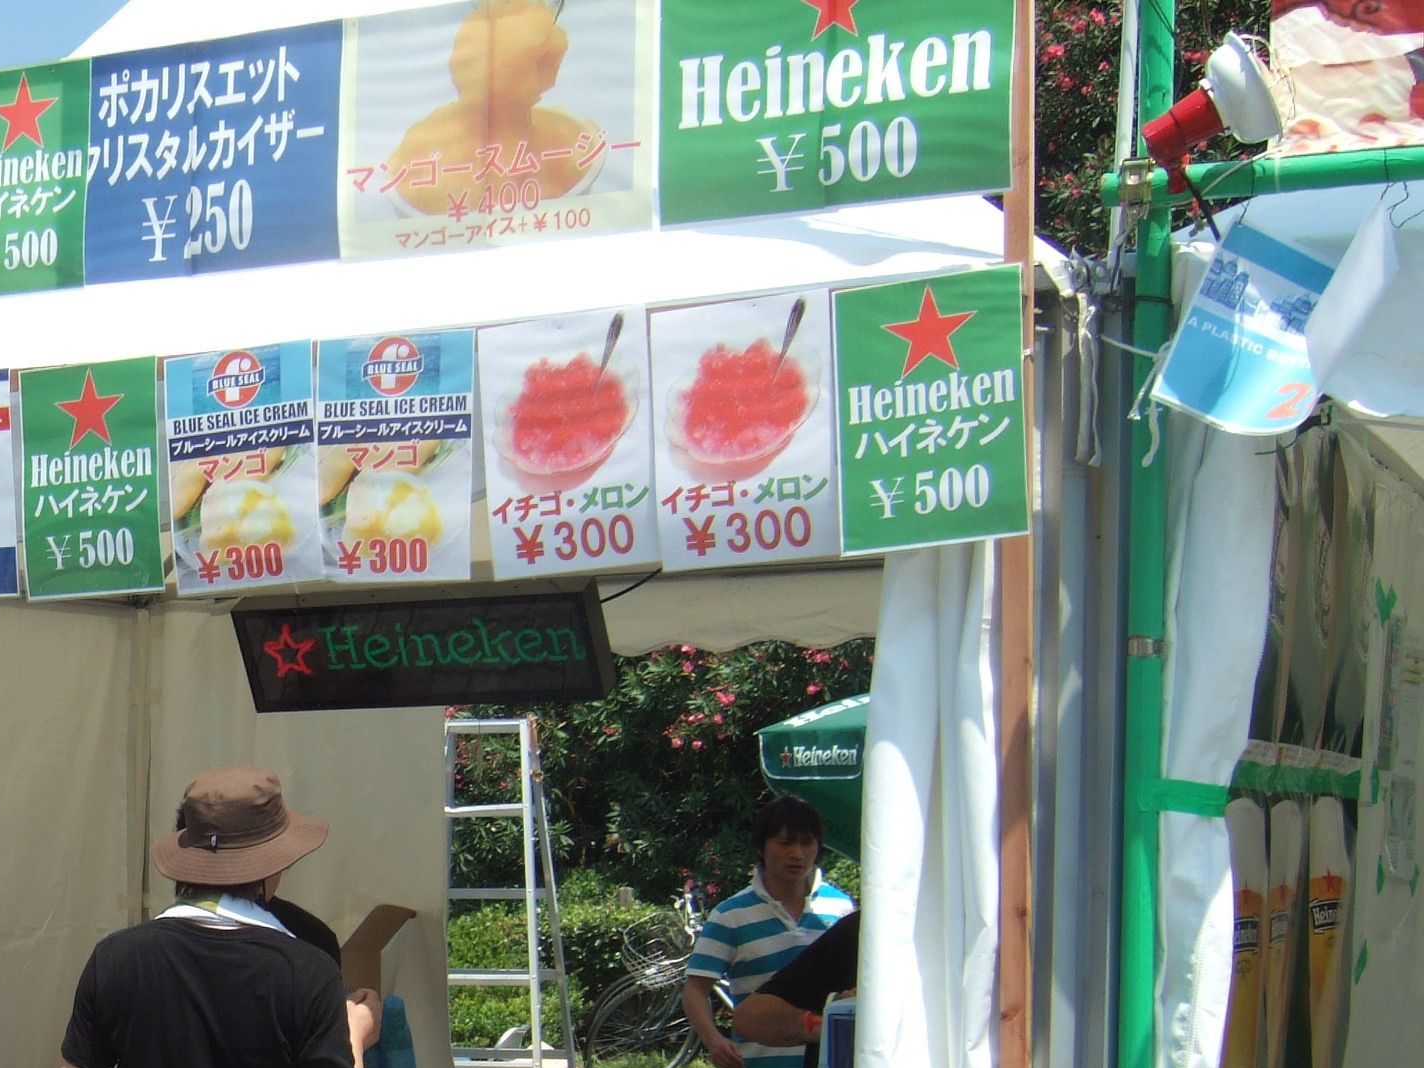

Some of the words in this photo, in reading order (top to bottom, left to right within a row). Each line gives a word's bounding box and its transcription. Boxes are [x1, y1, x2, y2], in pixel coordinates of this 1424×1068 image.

[98, 46, 300, 127] ポカリスエット
[678, 30, 991, 130] Heineken
[347, 129, 642, 194] マンゴースムージー
[212, 376, 237, 390] BLUE
[237, 373, 260, 387] SEAL
[366, 363, 393, 376] BLUE
[393, 360, 419, 374] SEAL
[324, 402, 356, 420] BLUE
[358, 400, 391, 417] SEAL
[393, 398, 417, 415] ICE
[419, 395, 468, 413] CREAM
[847, 367, 1016, 425] Heineken
[172, 416, 205, 436] BLUE
[206, 413, 238, 431] SEAL
[239, 410, 259, 427] ICE
[262, 401, 309, 423] CREAM
[319, 419, 468, 440] ブルーシールアイスクリーム
[853, 413, 1011, 460] ハイネケン
[170, 423, 312, 457] ブルーシールアイスクリーム
[346, 439, 421, 473] マンゴ
[30, 445, 153, 489] Heineken
[197, 449, 269, 485] マンゴ
[34, 484, 149, 519] ハイネケン
[492, 479, 650, 524] イチゴ・メロン
[661, 474, 829, 515] イチゴ・メロン
[320, 617, 587, 671] Heineken
[793, 744, 858, 767] Heineken
